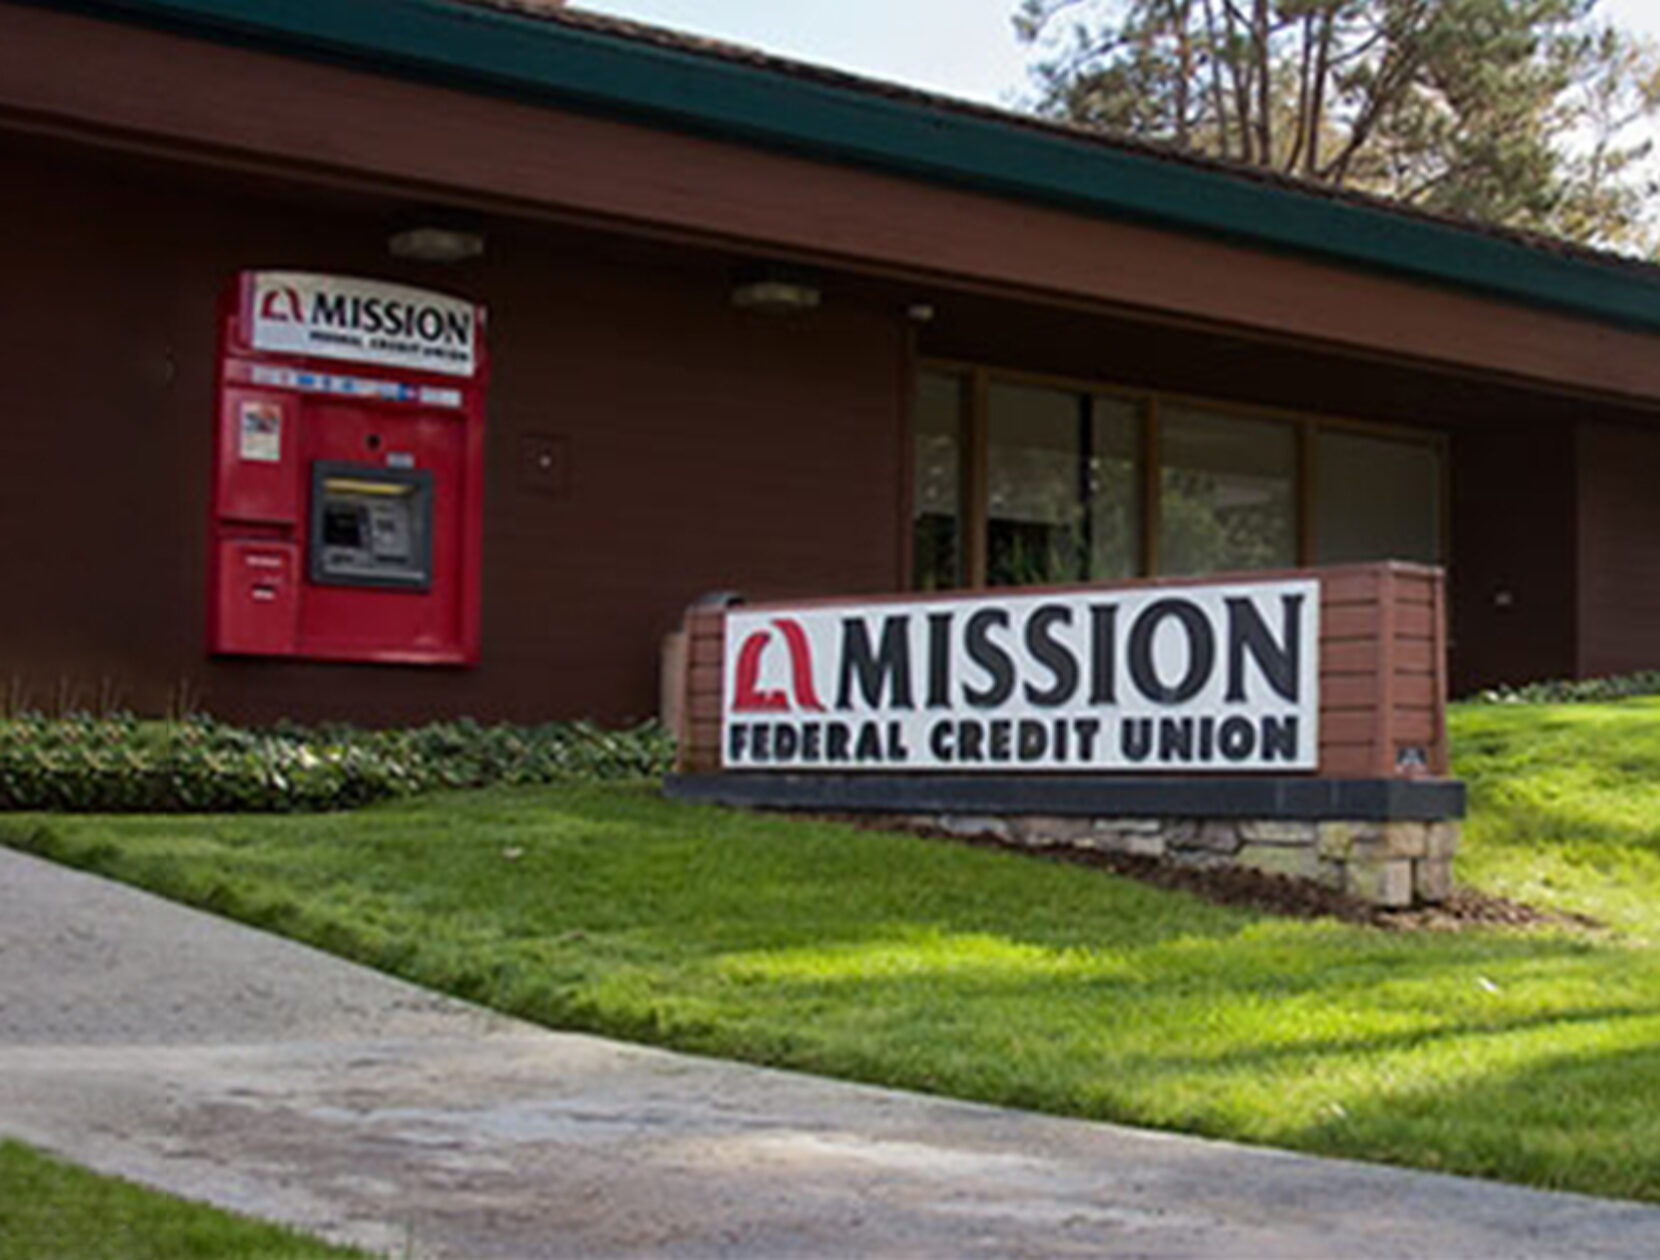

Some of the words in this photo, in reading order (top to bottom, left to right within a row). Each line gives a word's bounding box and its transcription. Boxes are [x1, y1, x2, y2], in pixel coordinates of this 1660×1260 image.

[311, 291, 470, 346] MISSION
[836, 593, 1305, 710] MISSION
[728, 718, 908, 762] FEDERAL
[929, 717, 1100, 762] CREDIT
[1121, 715, 1299, 762] UNION
